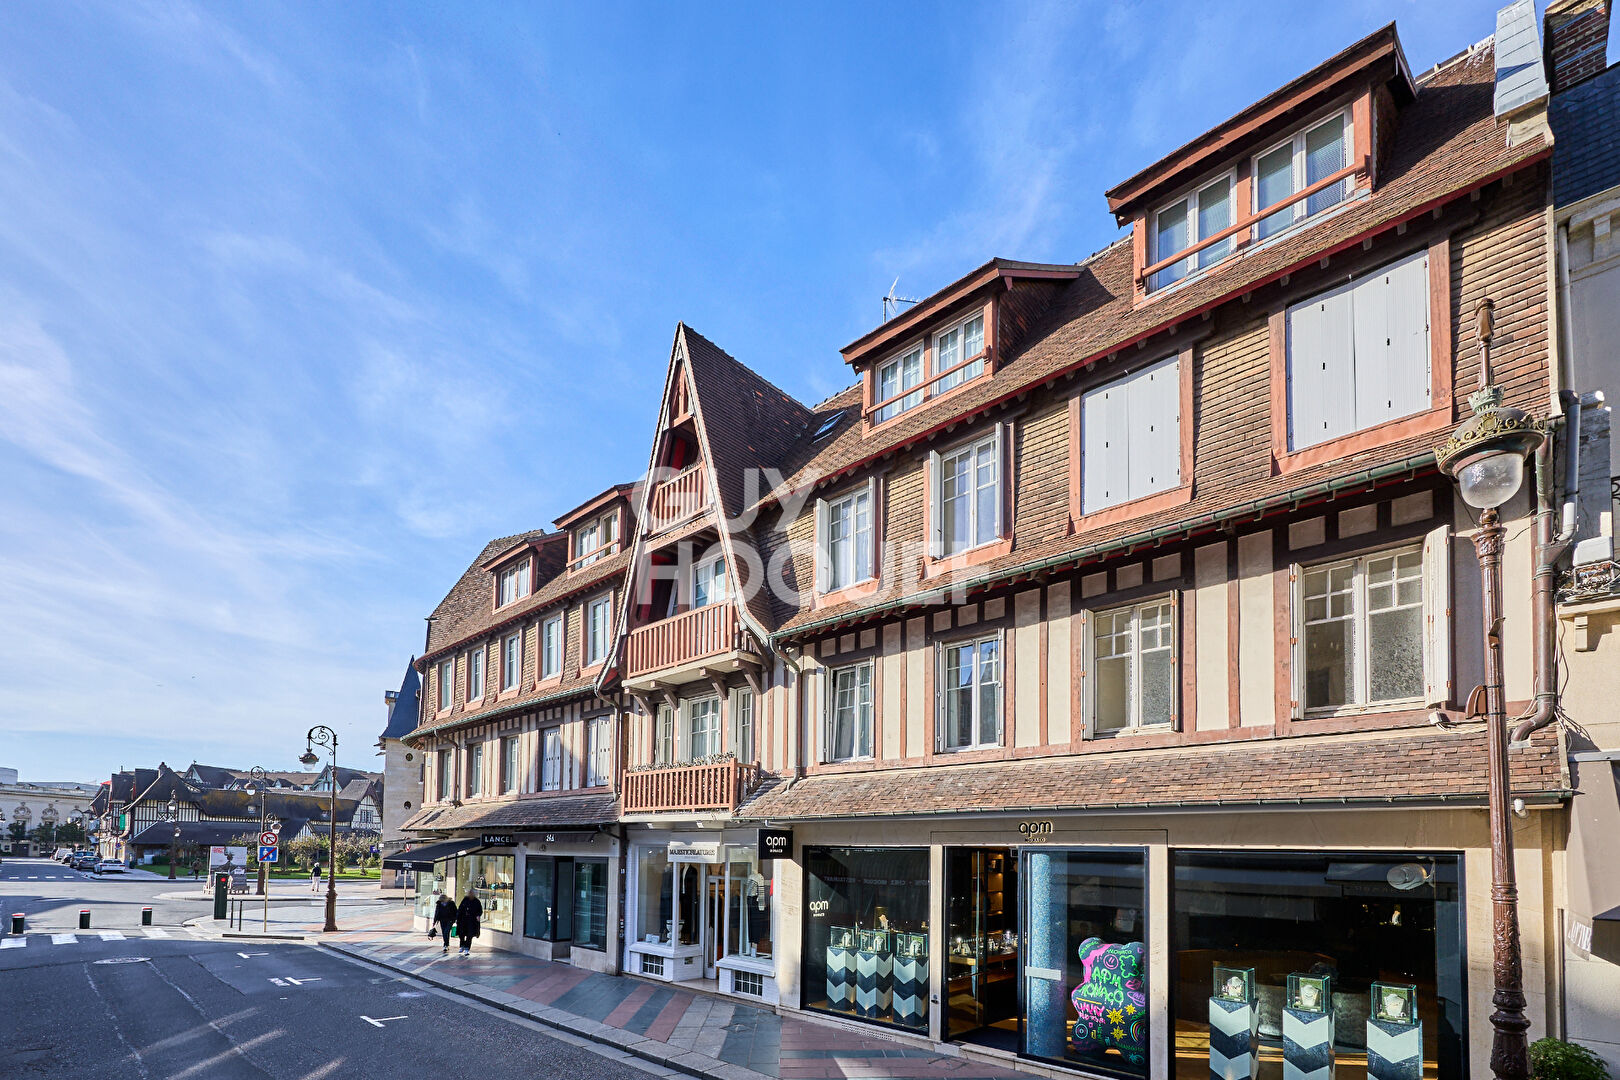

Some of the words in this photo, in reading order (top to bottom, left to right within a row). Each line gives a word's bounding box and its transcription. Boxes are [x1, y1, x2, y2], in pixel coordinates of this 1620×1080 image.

[1019, 821, 1053, 837] apm
[484, 835, 513, 843] LANCE
[766, 836, 786, 848] apm
[809, 900, 829, 914] apm
[1092, 966, 1123, 991] APM
